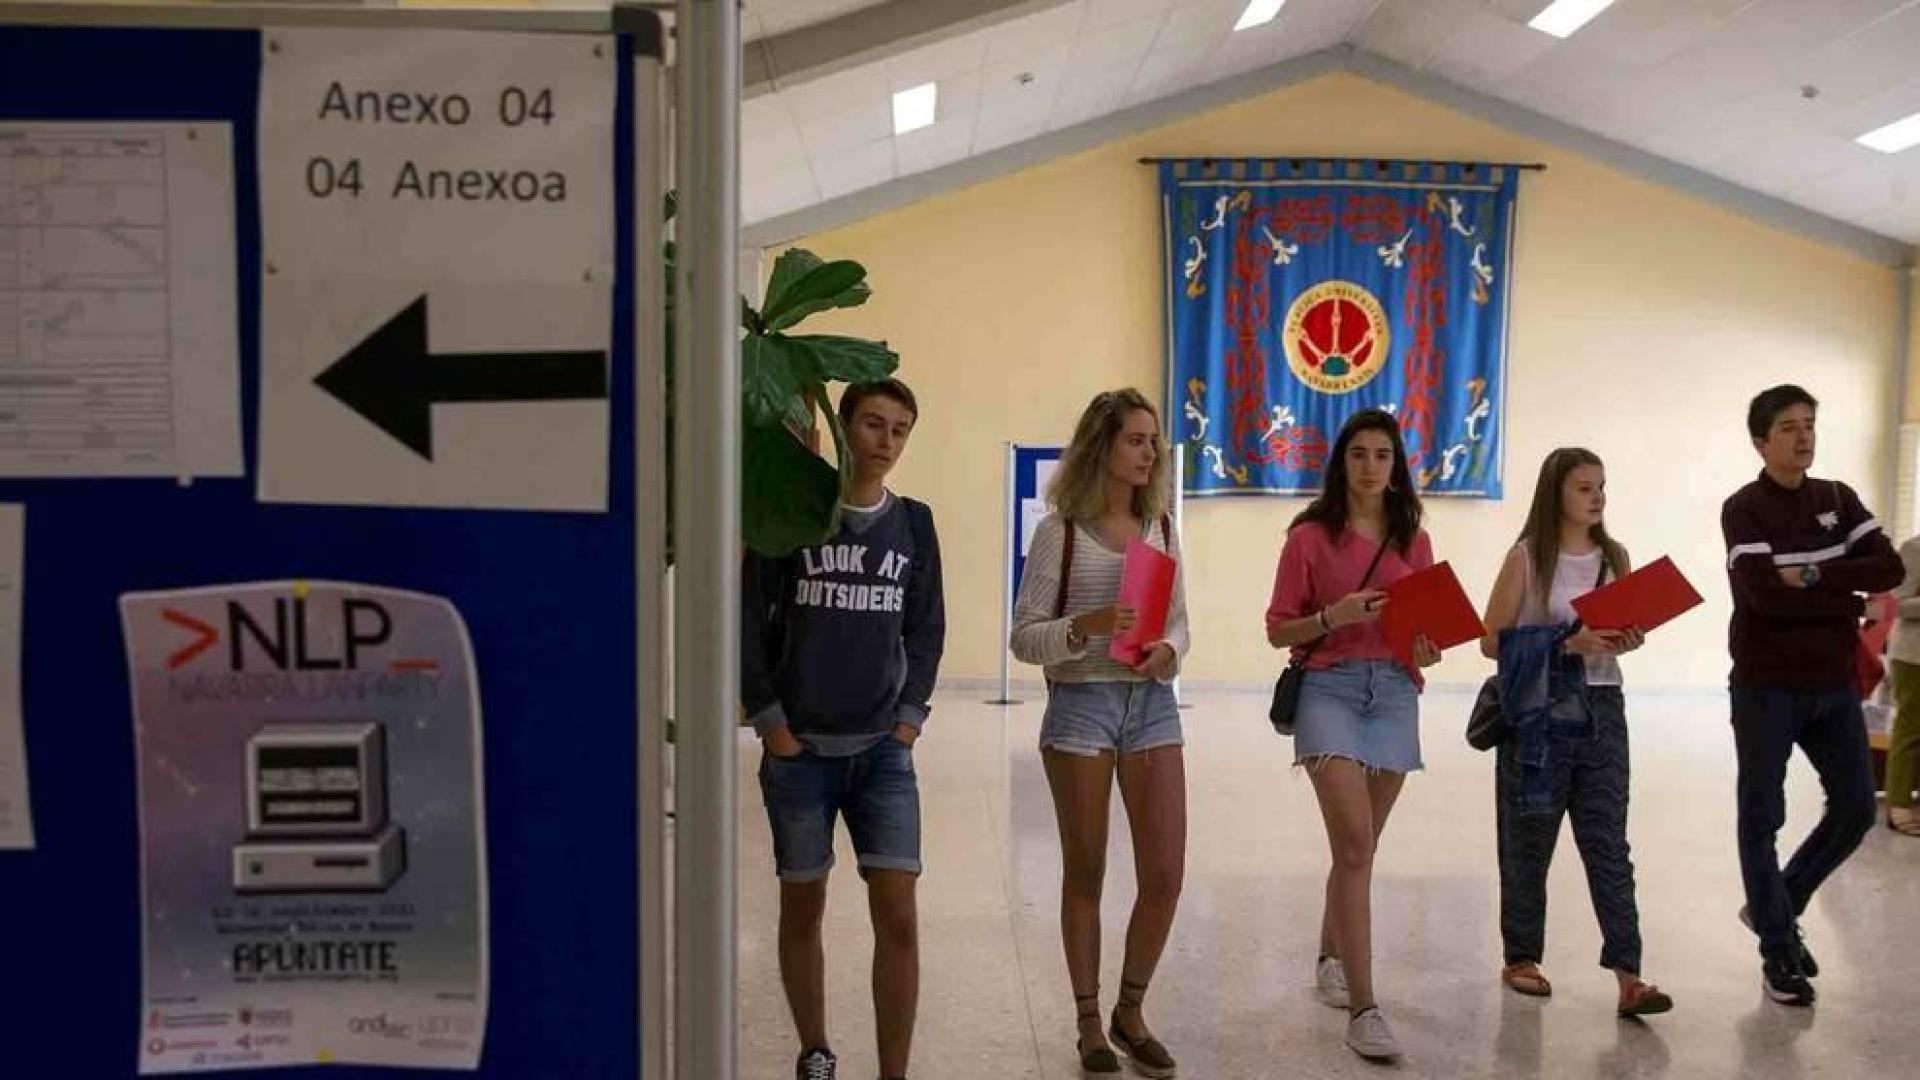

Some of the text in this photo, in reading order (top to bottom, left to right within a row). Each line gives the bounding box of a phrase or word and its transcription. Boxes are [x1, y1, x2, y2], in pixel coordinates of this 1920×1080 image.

[318, 81, 555, 126] Anexo 04
[306, 156, 567, 202] 04 Anexoa
[802, 545, 909, 581] LOOK AT
[795, 579, 904, 612] OUTSIDERS
